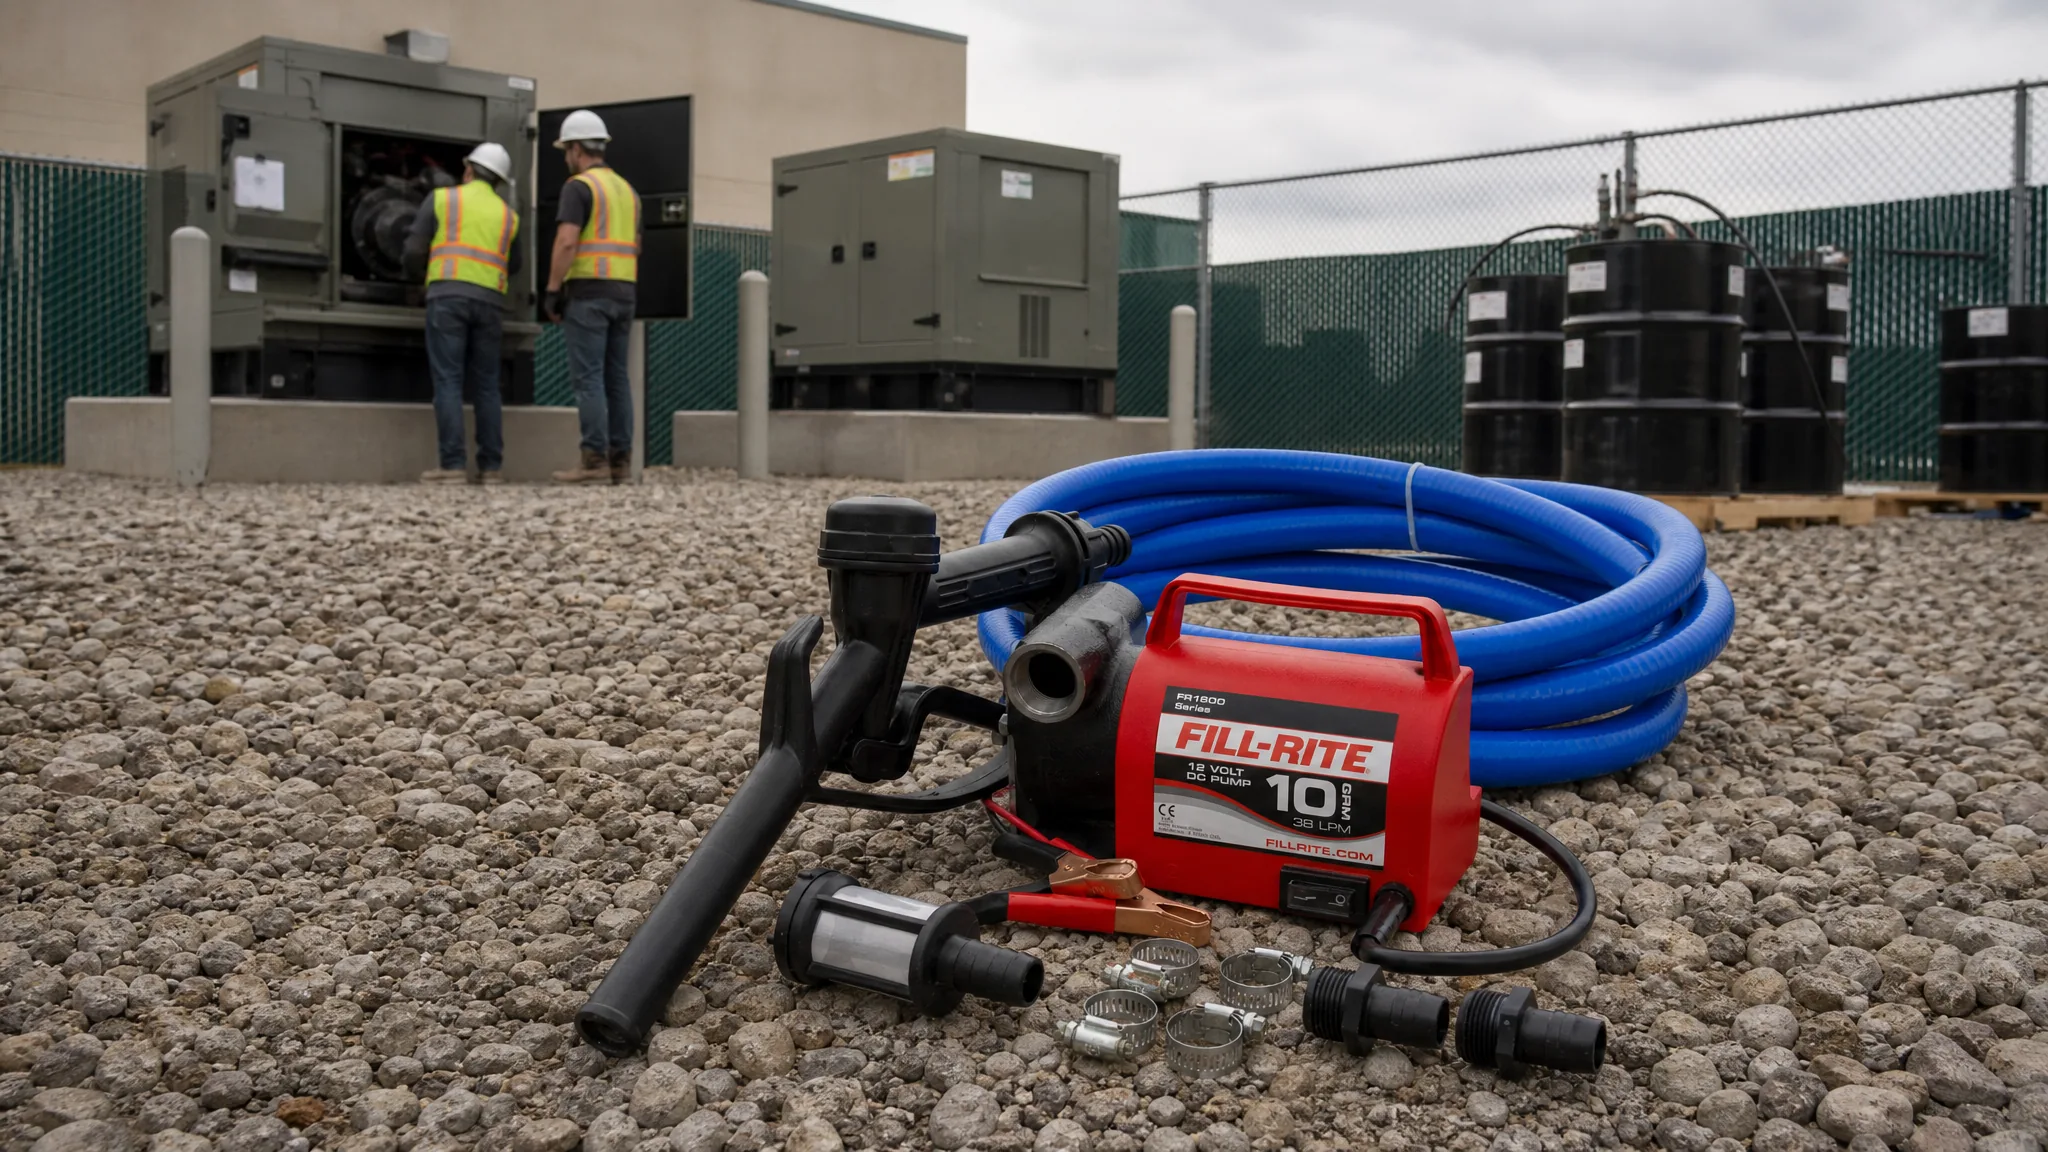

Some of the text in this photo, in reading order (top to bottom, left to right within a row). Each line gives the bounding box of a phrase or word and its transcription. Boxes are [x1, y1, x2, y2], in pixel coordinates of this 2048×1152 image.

[1175, 702, 1211, 713] Series
[1175, 722, 1373, 774] FILL-RITE
[1188, 762, 1244, 776] 12 VOLT
[1187, 772, 1251, 787] DC PUMP
[1266, 774, 1337, 818] 10
[1293, 817, 1351, 834] 38 LPM
[1266, 839, 1373, 862] FILLRITE.COM
